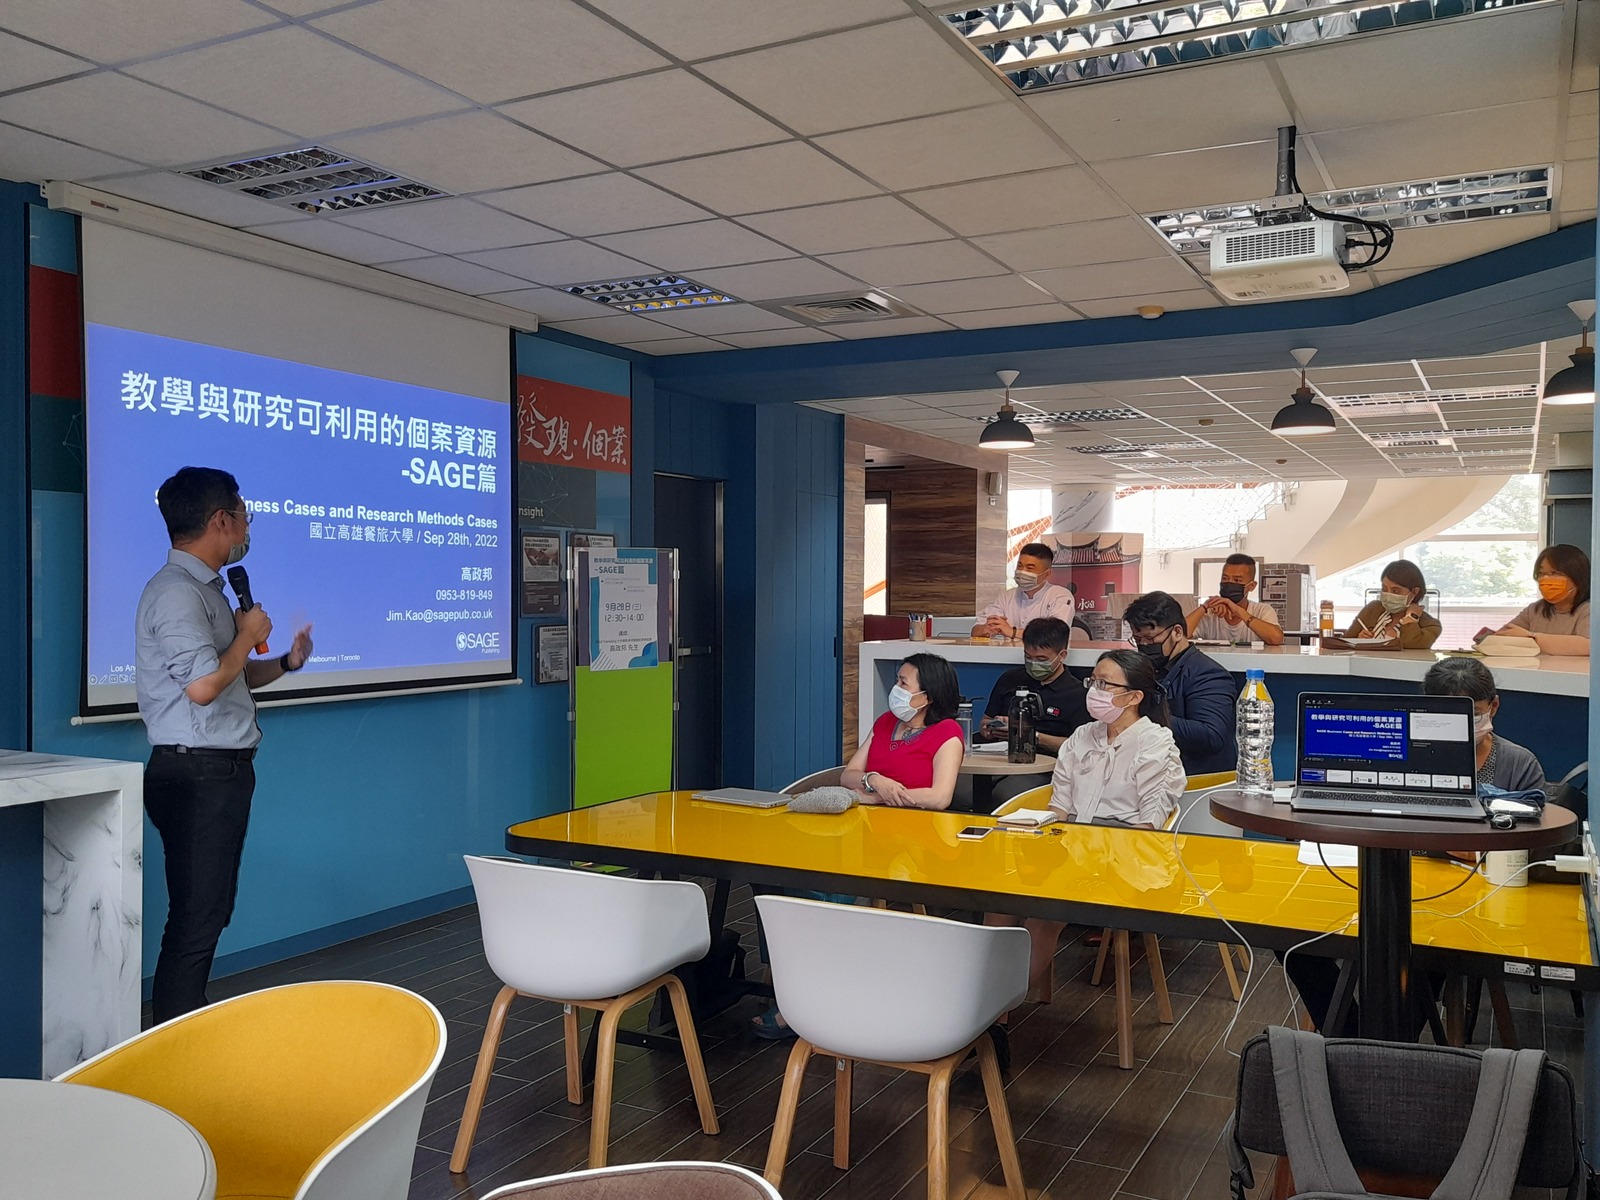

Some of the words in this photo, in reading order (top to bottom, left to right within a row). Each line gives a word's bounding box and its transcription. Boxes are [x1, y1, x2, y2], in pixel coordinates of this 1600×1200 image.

[121, 370, 497, 458] 教學與研究可利用的個案資源
[402, 457, 497, 494] -SAGE篇
[284, 499, 326, 517] Cases
[329, 505, 354, 519] and
[357, 506, 414, 523] Research
[417, 511, 465, 527] Methods
[467, 514, 498, 529] Cases
[309, 522, 414, 544] 國立高雄餐旅大學
[423, 531, 445, 547] Sep
[447, 533, 472, 548] 28th,
[475, 535, 498, 548] 2022
[461, 567, 493, 582] 高政邦
[435, 589, 493, 601] 0953-819-849
[386, 609, 493, 623] Jim.Kao@sagepub.co.uk
[110, 664, 124, 673] Los
